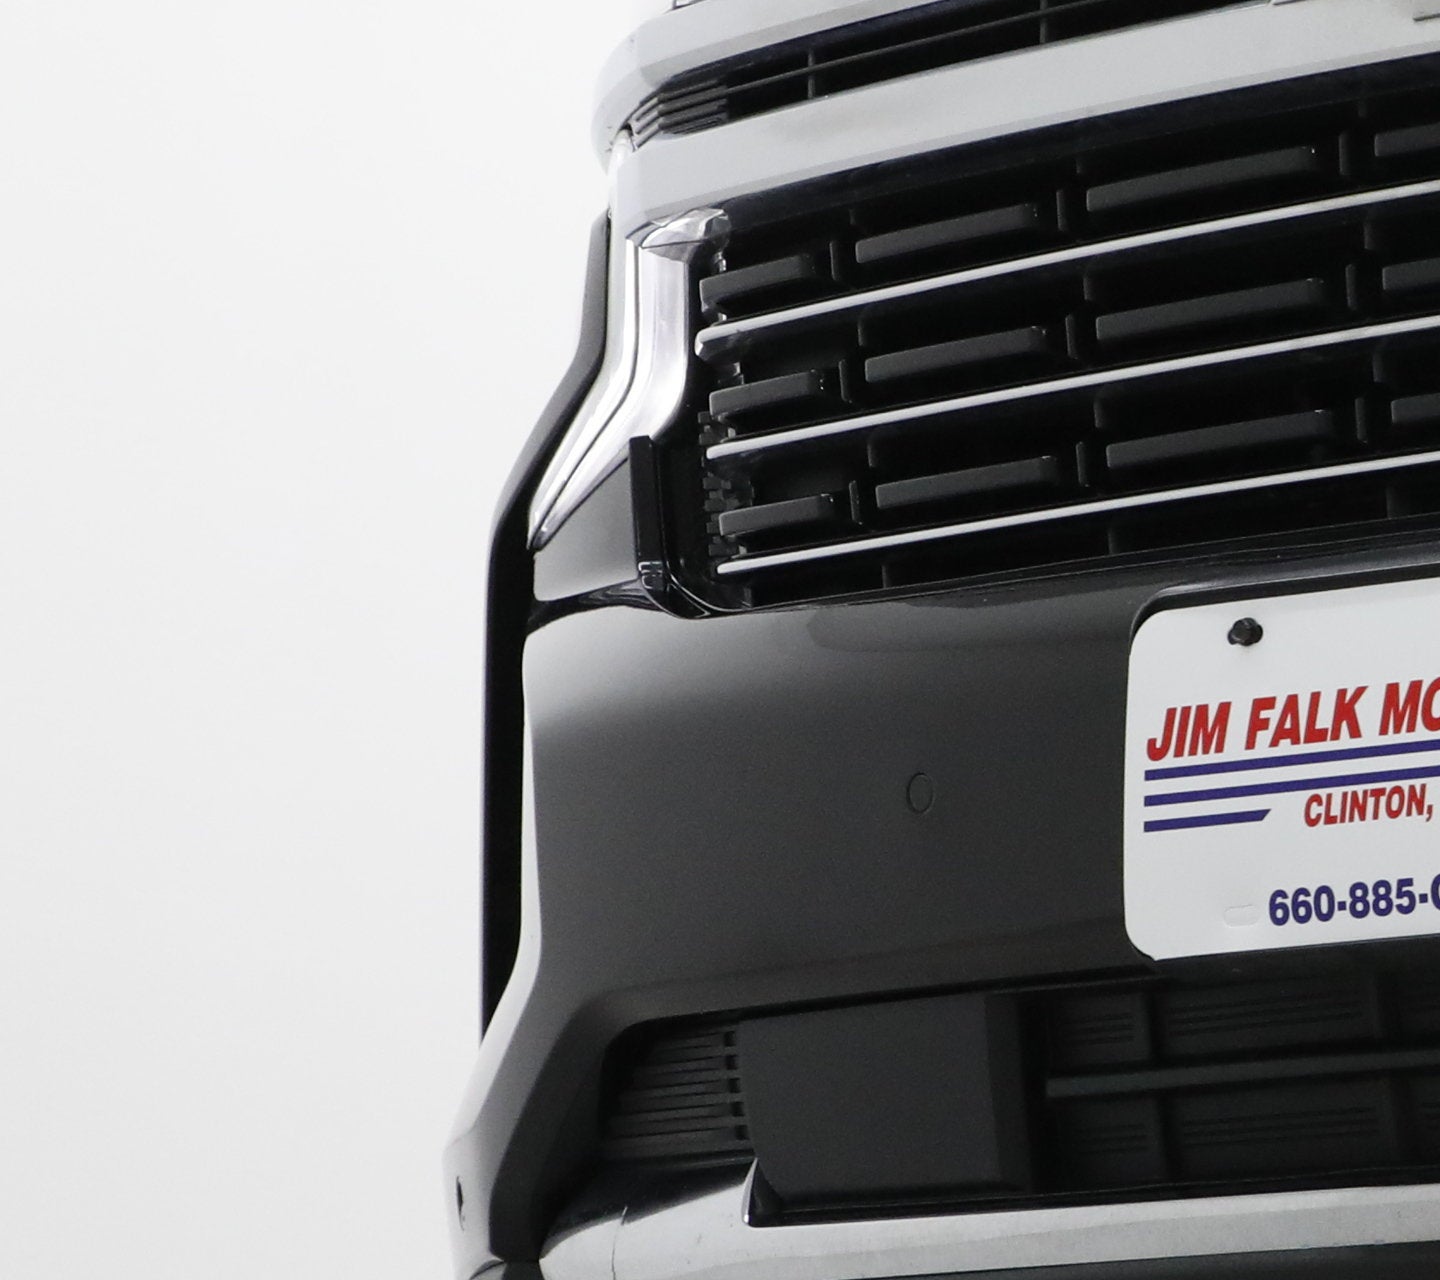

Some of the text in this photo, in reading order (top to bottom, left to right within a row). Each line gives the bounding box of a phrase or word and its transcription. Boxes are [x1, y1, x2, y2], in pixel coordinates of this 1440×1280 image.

[1146, 701, 1232, 762] JIM
[1245, 685, 1369, 750] FALK
[1304, 783, 1434, 827] CLINTON,
